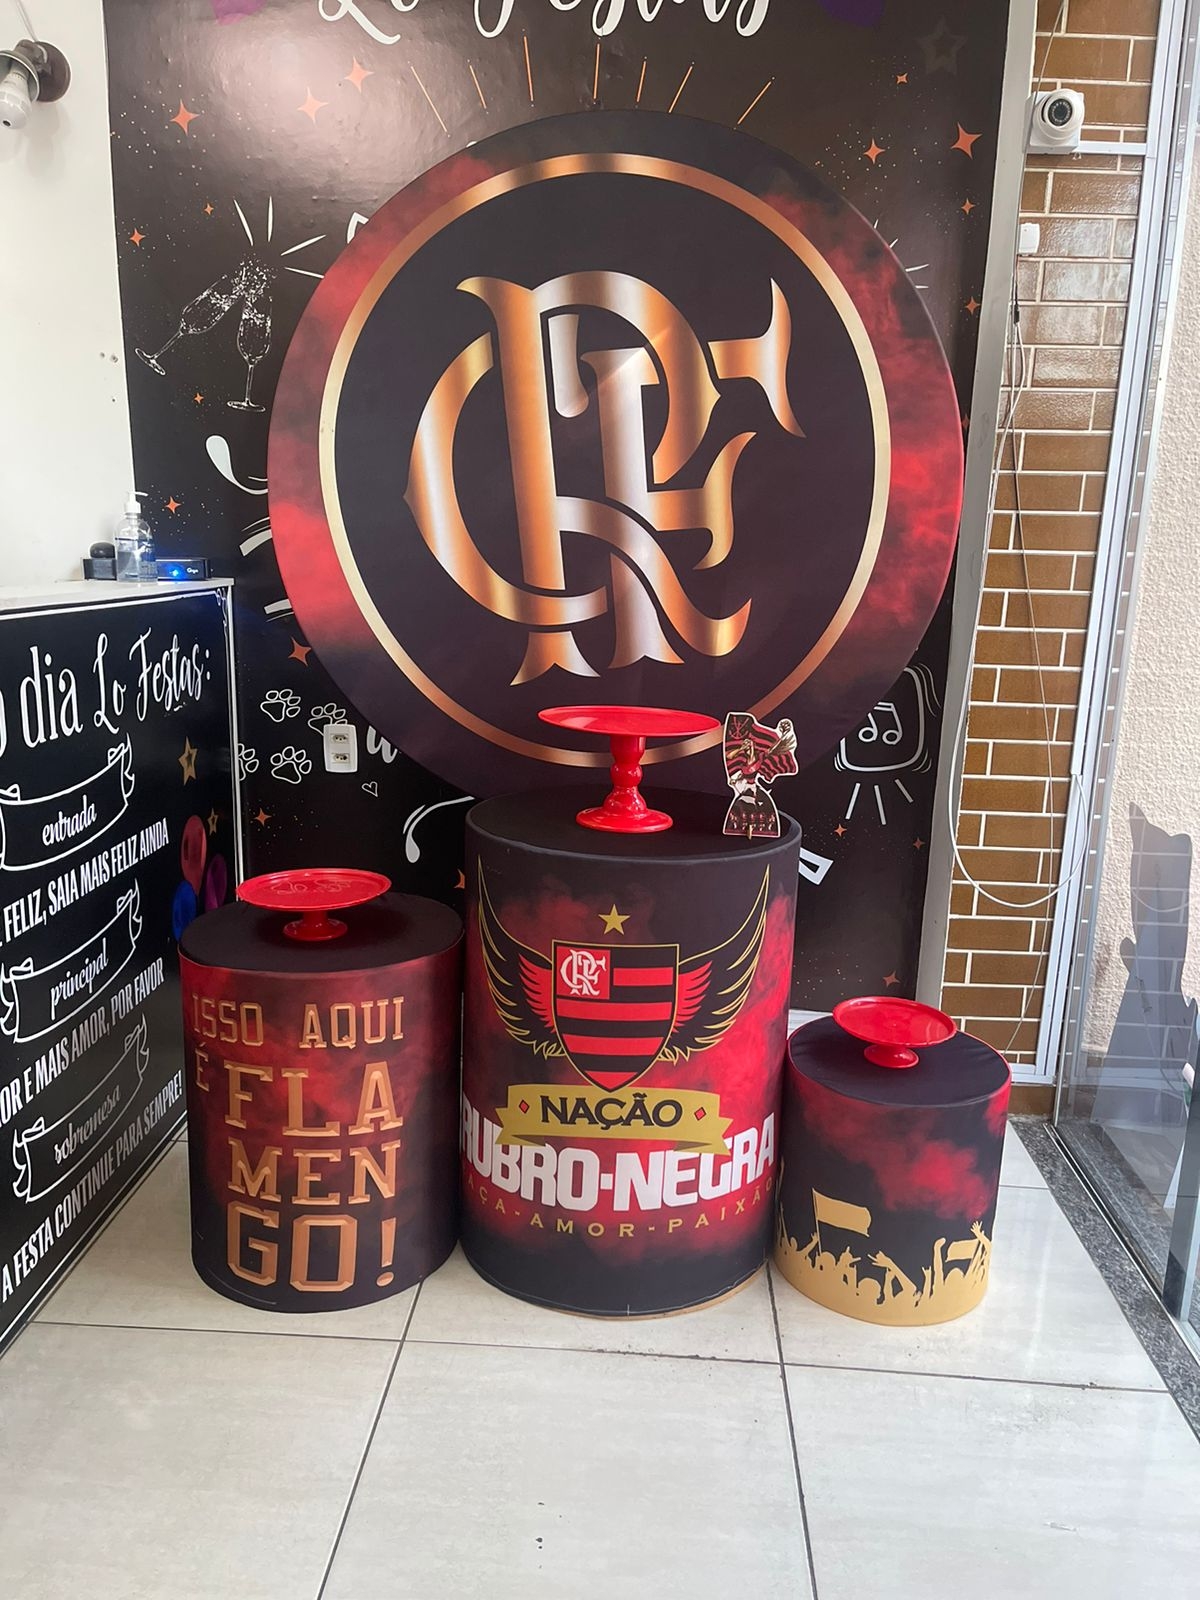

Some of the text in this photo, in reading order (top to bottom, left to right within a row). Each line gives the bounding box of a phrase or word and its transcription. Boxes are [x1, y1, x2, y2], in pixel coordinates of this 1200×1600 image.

[19, 645, 84, 749] dia
[93, 632, 127, 735] Lo
[129, 627, 211, 722] Festas:
[42, 794, 97, 846] entrada
[3, 817, 169, 943] FELIZ, SAIA MAIS FELIZ AINDA
[50, 937, 109, 1021] principal
[191, 992, 405, 1049] ISSO AQUI
[0, 956, 164, 1129] OR E MAIS AMOR, POR FAVOR
[54, 1084, 121, 1165] sobremesa
[195, 1041, 404, 1137] É FLA
[539, 1092, 683, 1130] NAÇÃO
[2, 1069, 183, 1303] A FESTA CONTINUE PARA SEMPRE!
[227, 1136, 401, 1206] MEN
